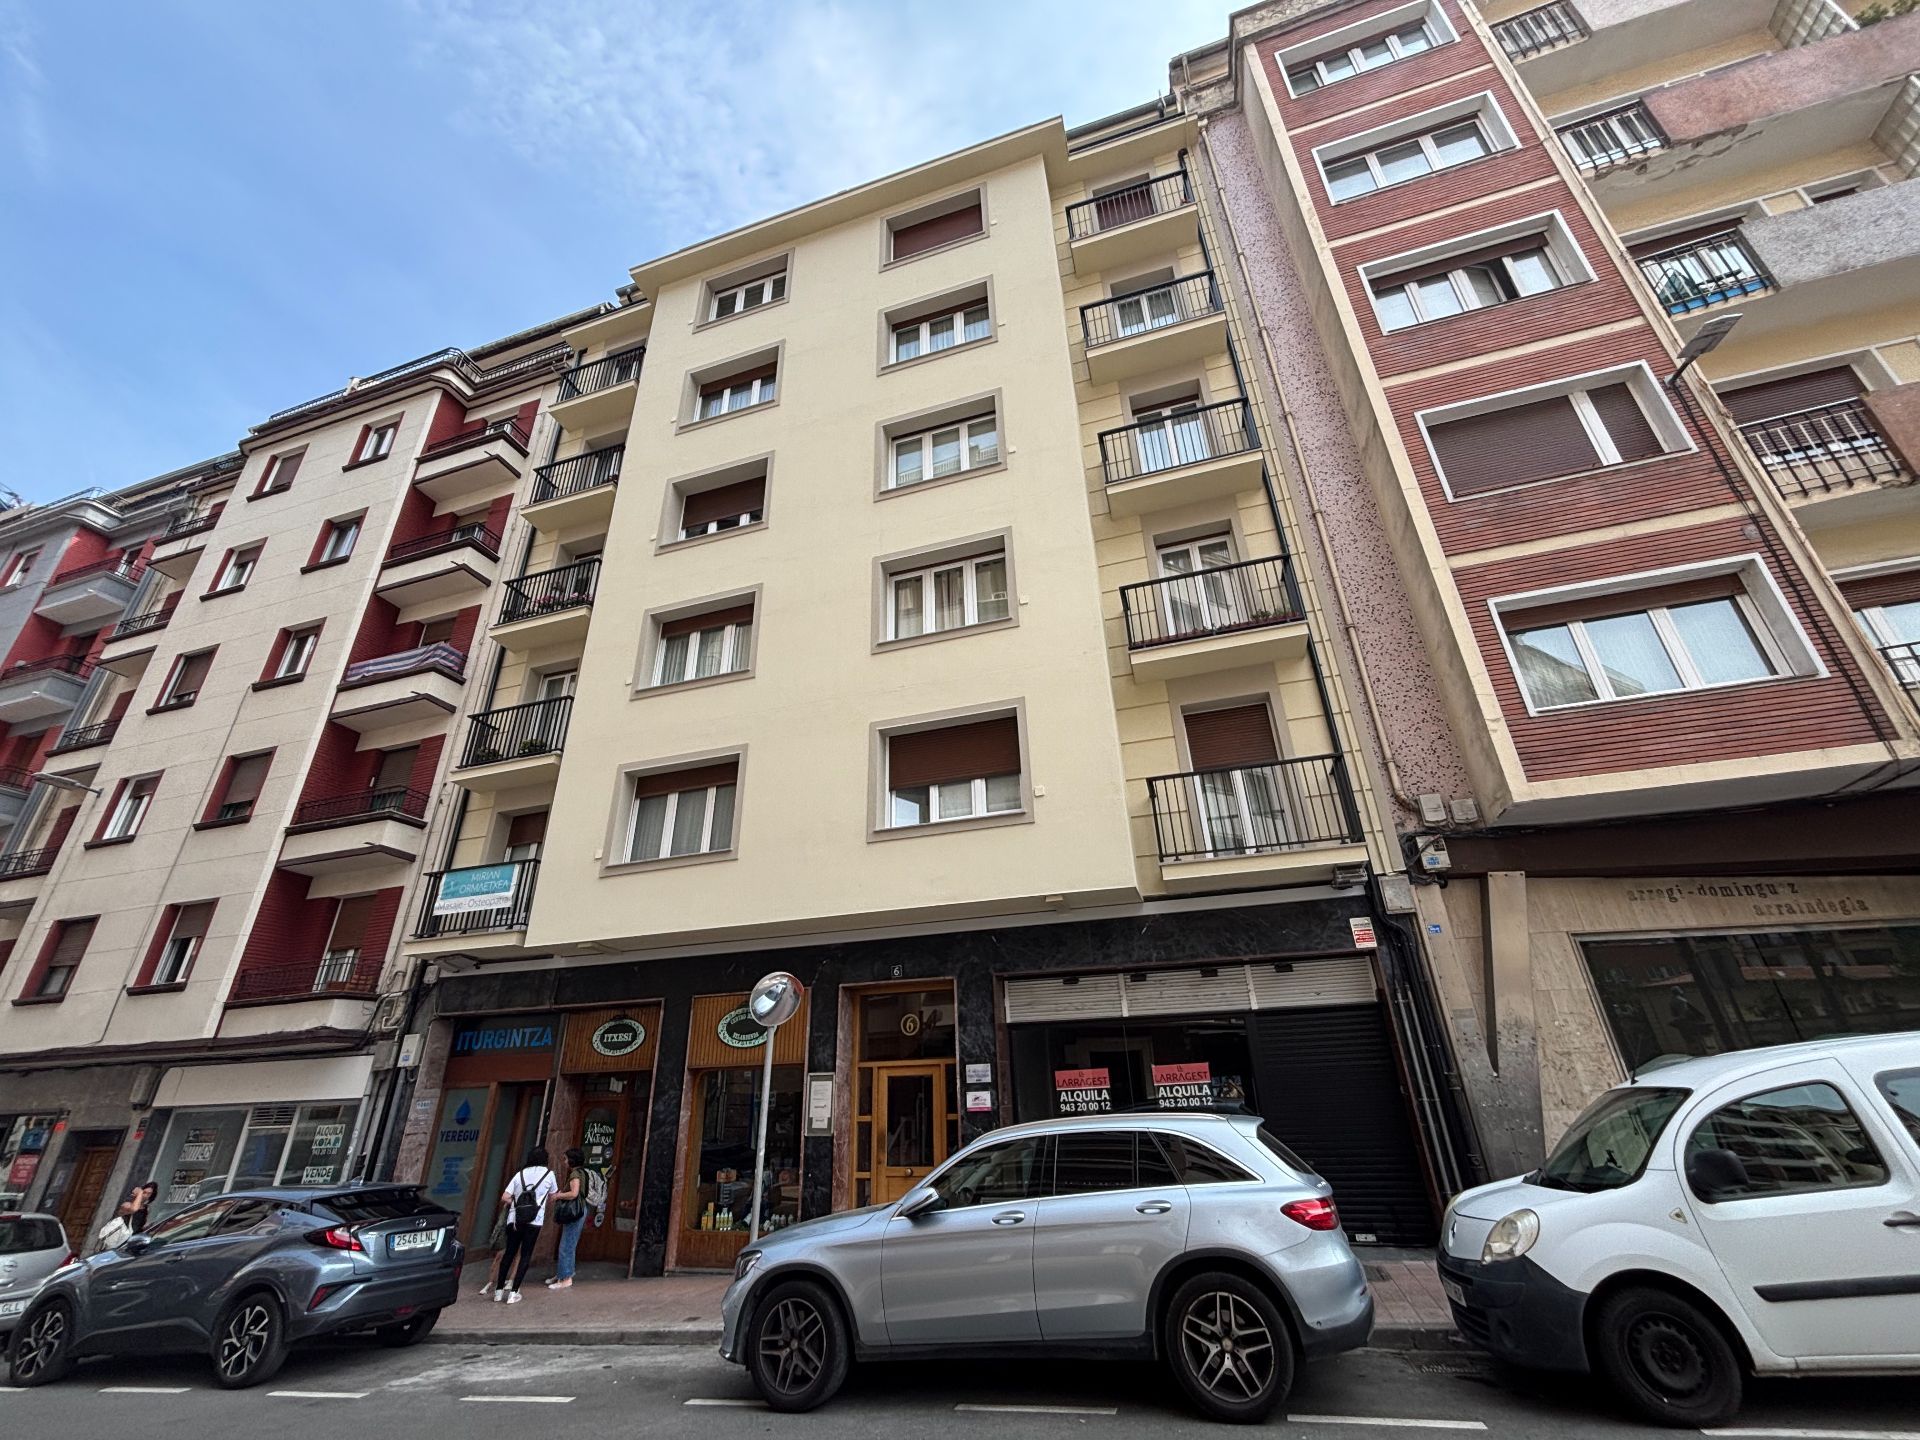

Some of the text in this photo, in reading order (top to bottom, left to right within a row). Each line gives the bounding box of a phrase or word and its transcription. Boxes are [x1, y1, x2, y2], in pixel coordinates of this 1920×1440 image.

[471, 870, 502, 882] MIRIAN
[459, 880, 509, 894] ORMAETXEA
[1627, 880, 1800, 902] arregi-dominguz
[906, 1017, 914, 1033] 6
[456, 1025, 553, 1051] ITURGINTZA
[603, 1032, 633, 1043] ITXESI
[1057, 1076, 1108, 1088] LARRAGEST
[1155, 1070, 1208, 1083] LARRAGEST
[1059, 1089, 1110, 1103] ALQUILA
[1158, 1084, 1212, 1098] ALQUILA
[1060, 1101, 1112, 1112] 943 20 00 12
[1159, 1096, 1214, 1108] 943 20 00 12
[316, 1126, 344, 1136] ALQUILA
[305, 1168, 332, 1179] VENDE
[396, 1231, 436, 1246] 2546 LNL
